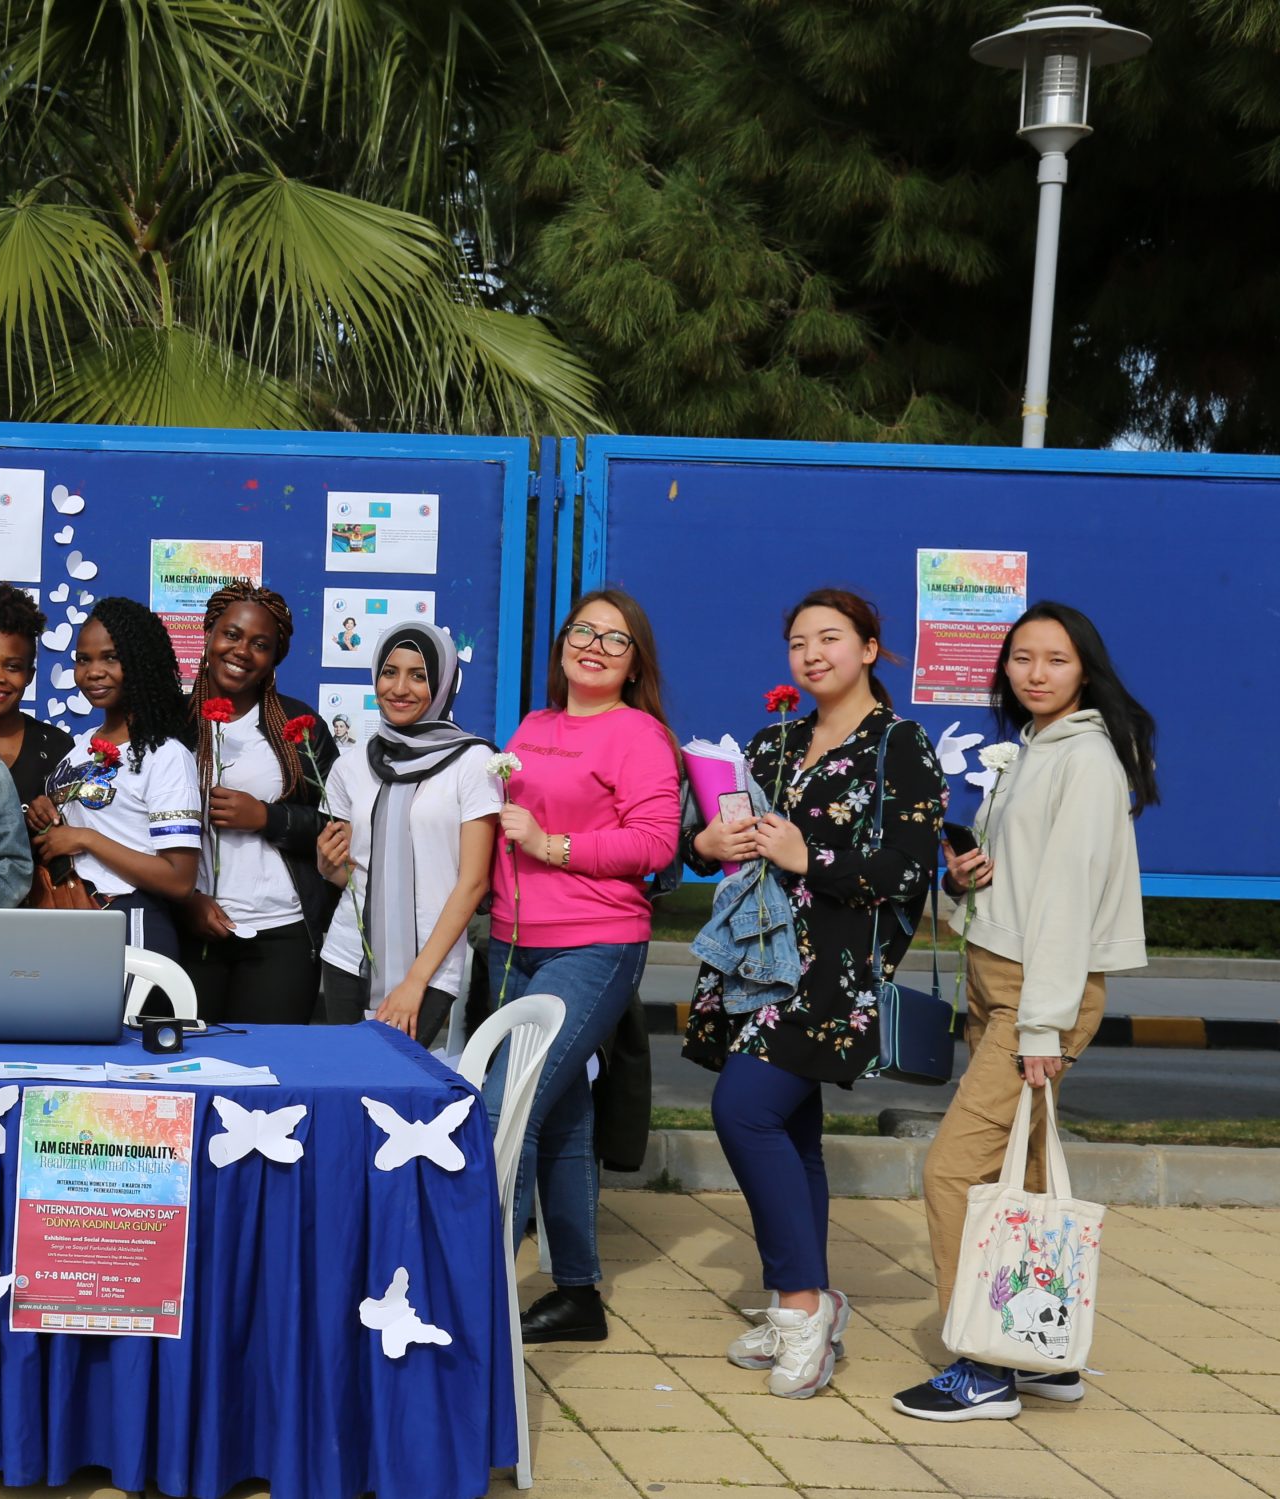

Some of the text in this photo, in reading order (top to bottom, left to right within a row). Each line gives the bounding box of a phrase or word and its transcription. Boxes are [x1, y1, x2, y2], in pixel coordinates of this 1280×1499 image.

[164, 575, 175, 583] AM
[176, 575, 218, 584] GENERATION
[931, 584, 941, 592] AM
[942, 584, 984, 593] GENERATION
[34, 1141, 178, 1160] I AM GENERATION EQUALITY:
[40, 1156, 171, 1174] Realizing Women's Rights
[36, 1204, 108, 1217] INTERNATIONAL
[111, 1207, 156, 1219] WOMEN'S
[82, 1218, 131, 1230] KADINLAR
[35, 1271, 96, 1281] 6-7-8 MARCH
